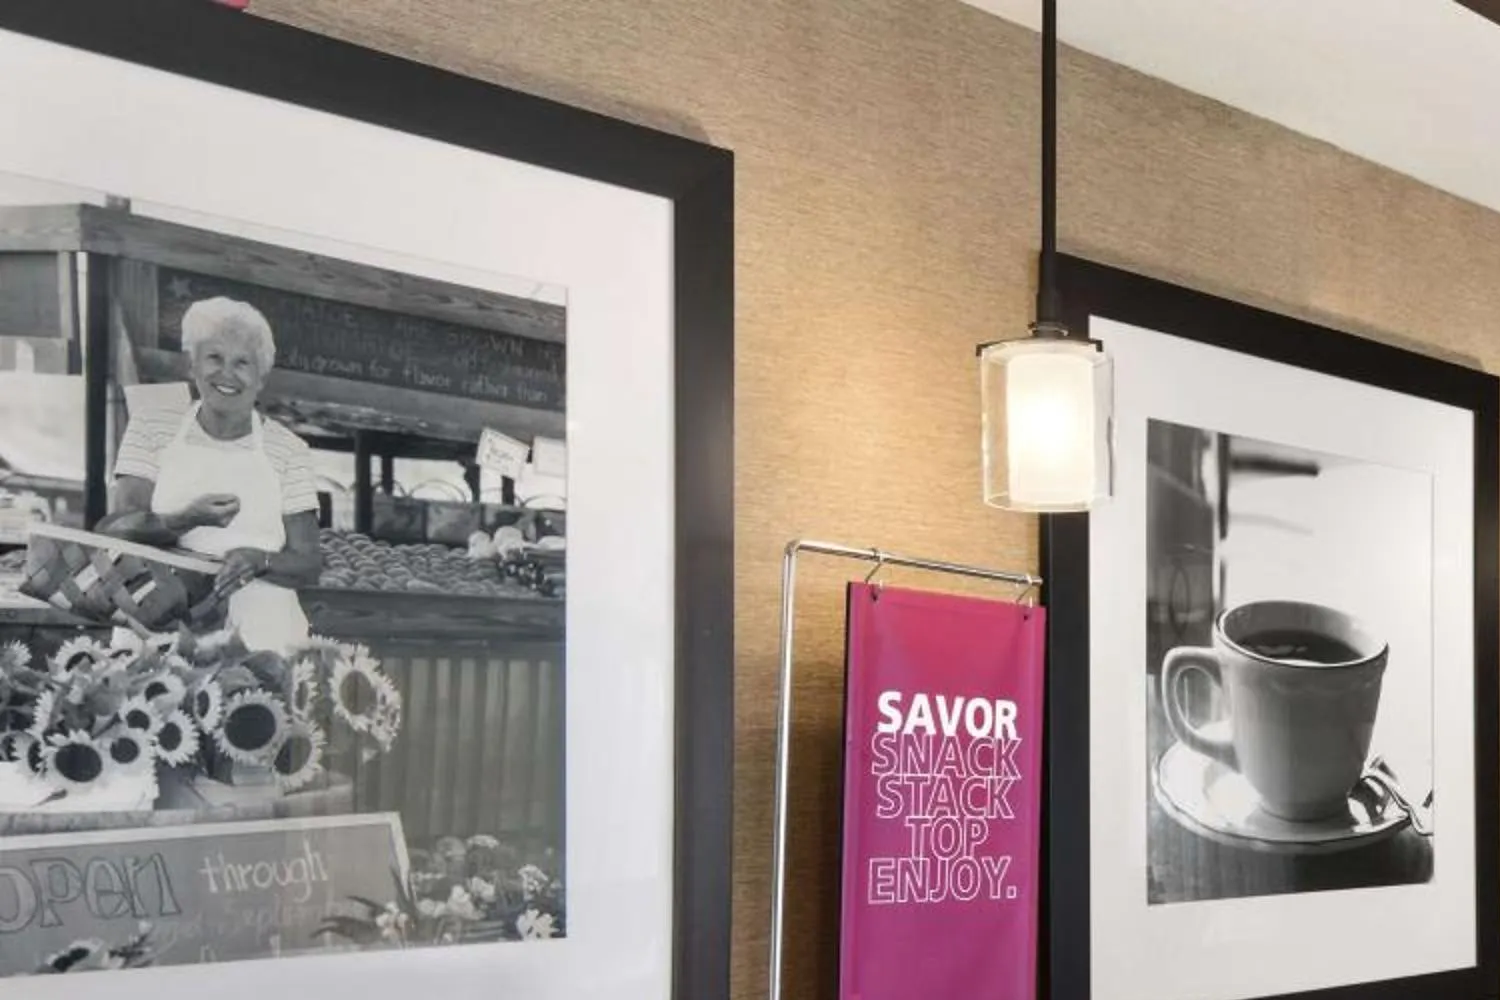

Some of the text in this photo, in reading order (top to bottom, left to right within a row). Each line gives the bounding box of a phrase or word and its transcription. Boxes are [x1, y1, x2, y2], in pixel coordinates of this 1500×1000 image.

[877, 690, 1018, 739] SAVOR
[871, 732, 1022, 780] SNACK
[876, 773, 1015, 819] STACK
[905, 815, 988, 861] TOP
[200, 838, 329, 902] through
[868, 856, 1018, 905] ENJOY.
